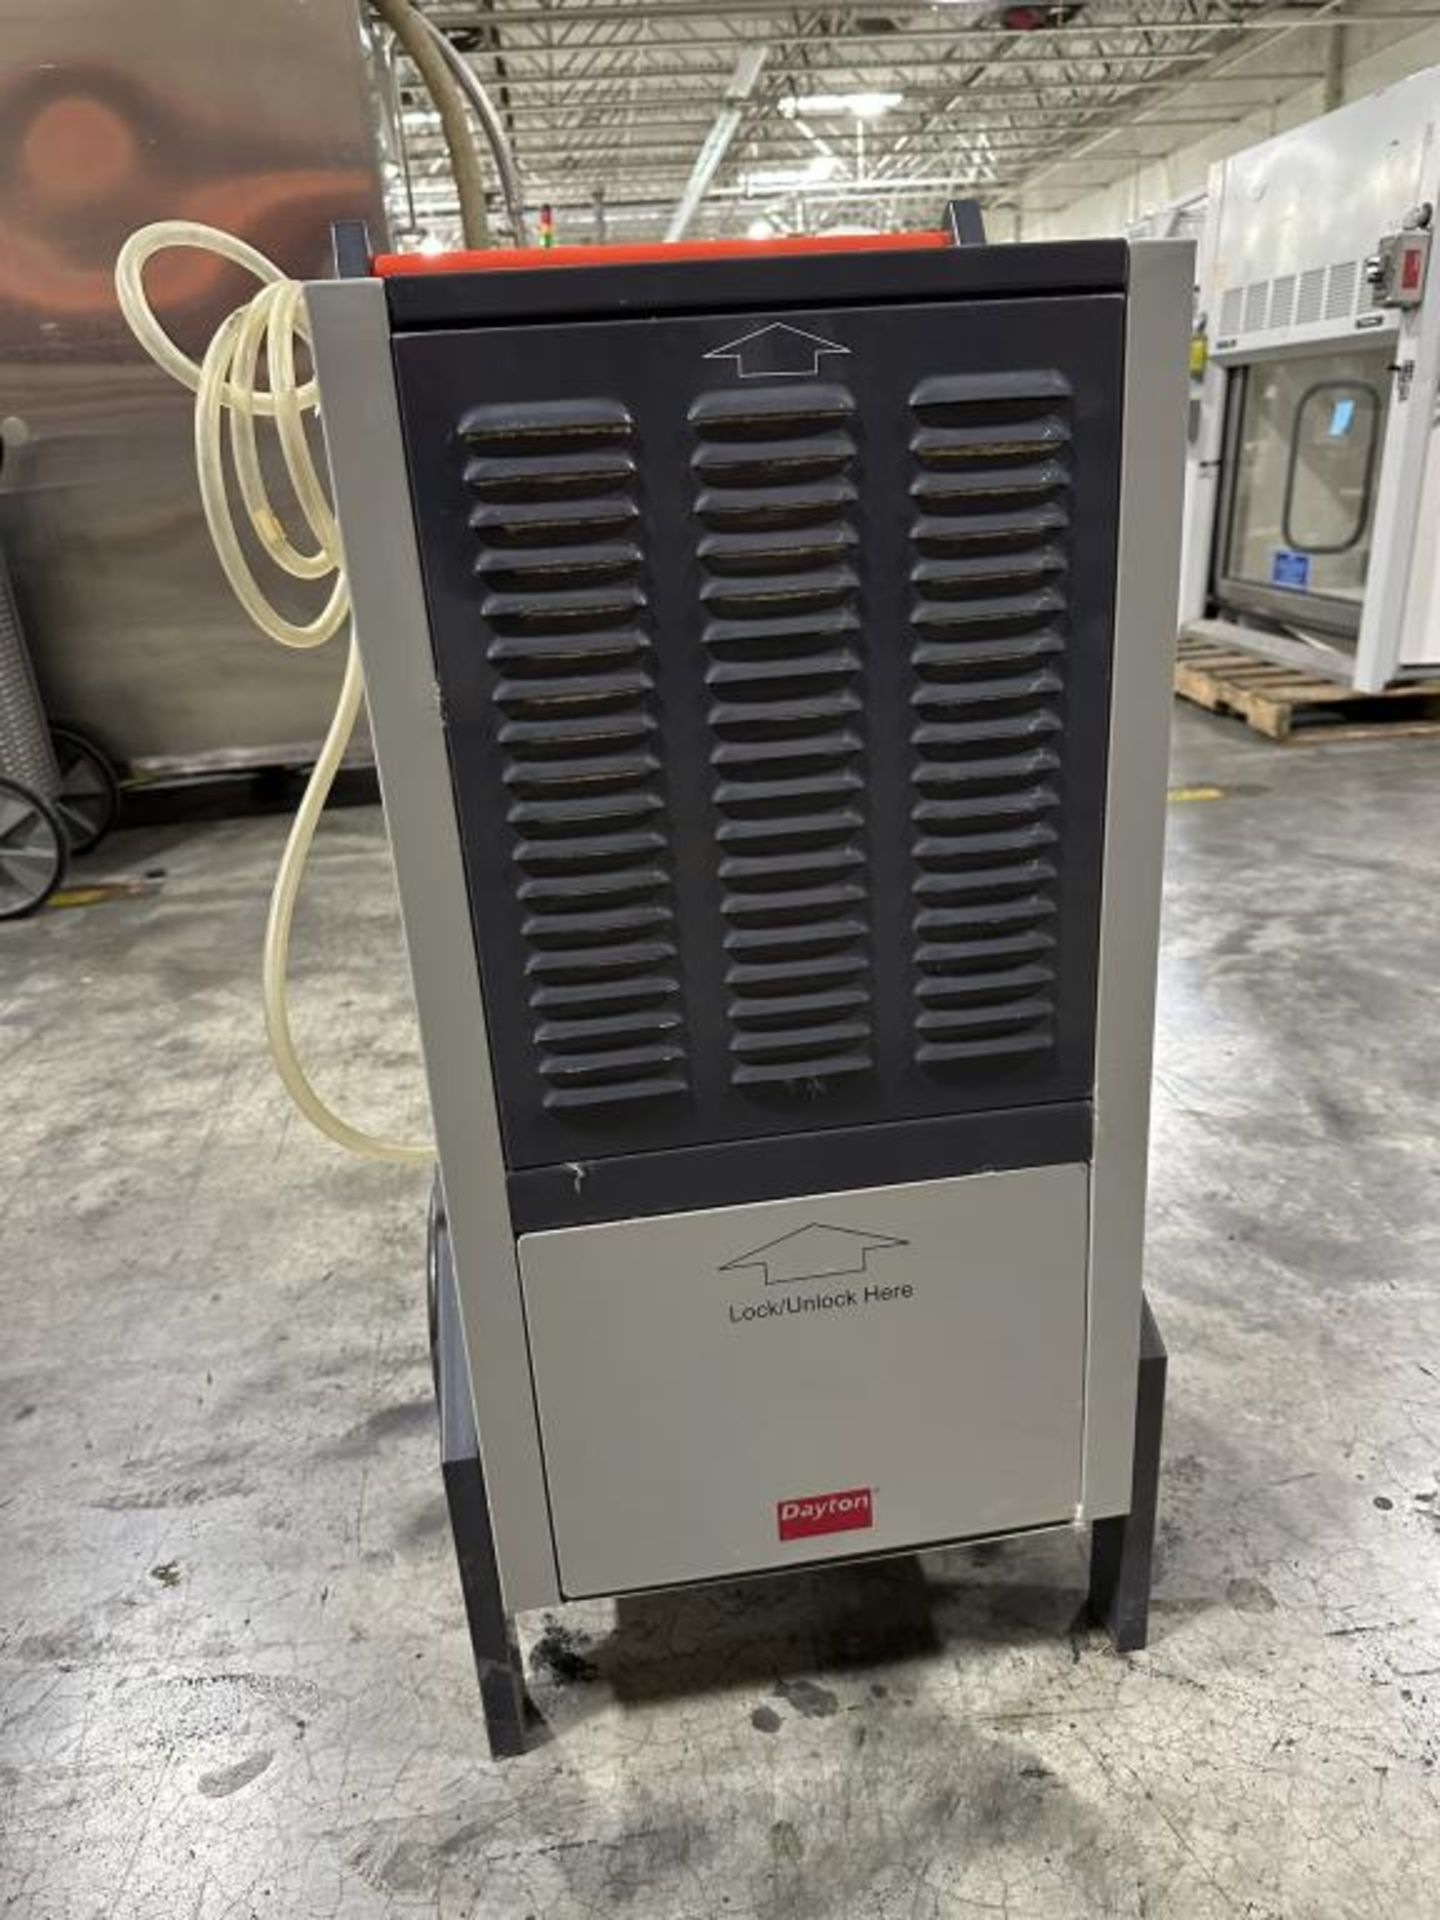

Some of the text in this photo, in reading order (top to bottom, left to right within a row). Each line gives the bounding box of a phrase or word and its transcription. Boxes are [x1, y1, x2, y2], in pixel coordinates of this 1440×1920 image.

[729, 1283, 914, 1323] Lock/Unlock Here
[781, 1495, 869, 1521] Dayton
